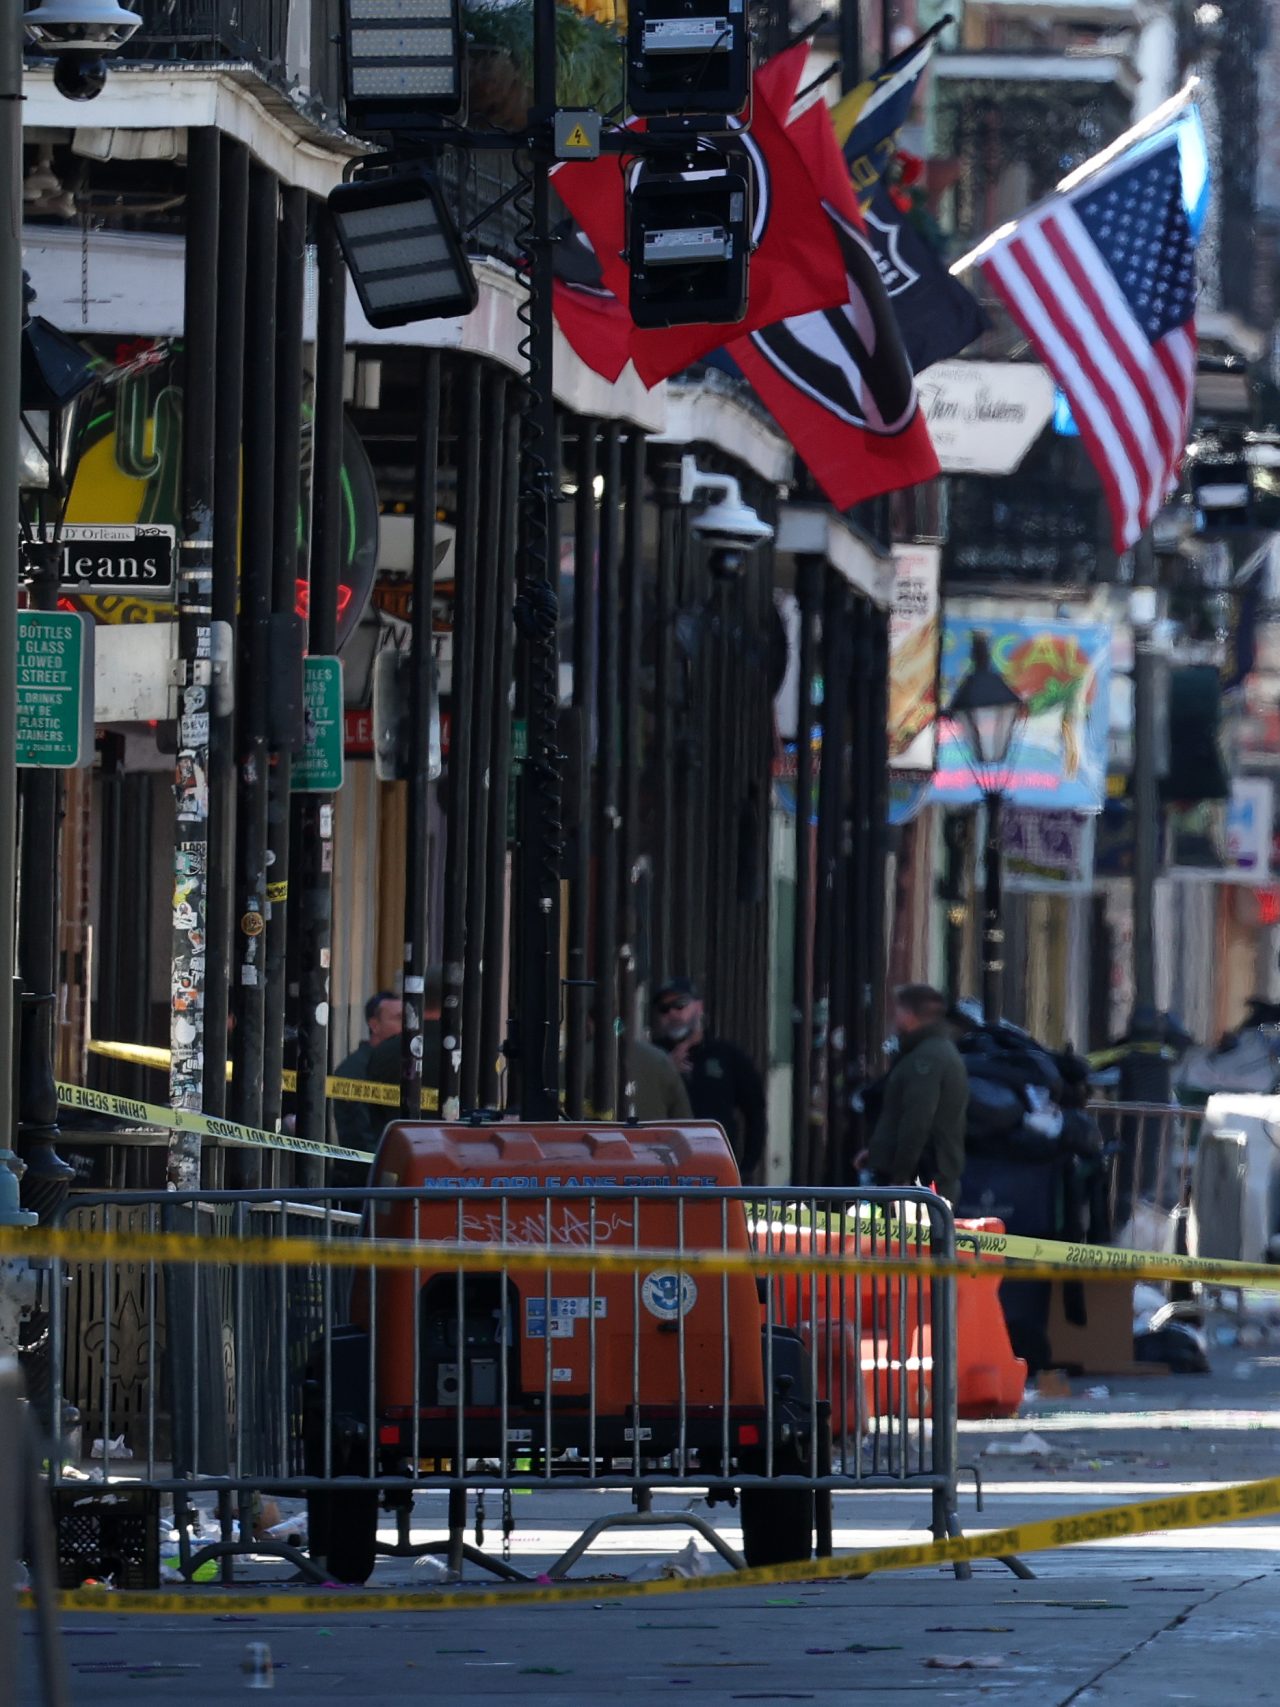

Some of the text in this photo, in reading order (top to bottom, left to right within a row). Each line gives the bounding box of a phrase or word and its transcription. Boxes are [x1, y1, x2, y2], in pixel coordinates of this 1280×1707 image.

[62, 547, 157, 578] leans
[19, 625, 72, 639] BOTTLES
[25, 640, 65, 654] GLASS
[21, 669, 67, 683] STREET
[57, 1085, 148, 1120] CRIME SCENE DO
[206, 1119, 243, 1136] CROSS
[246, 1128, 266, 1144] NOT
[268, 1132, 284, 1147] DO
[288, 1137, 321, 1151] SCENE
